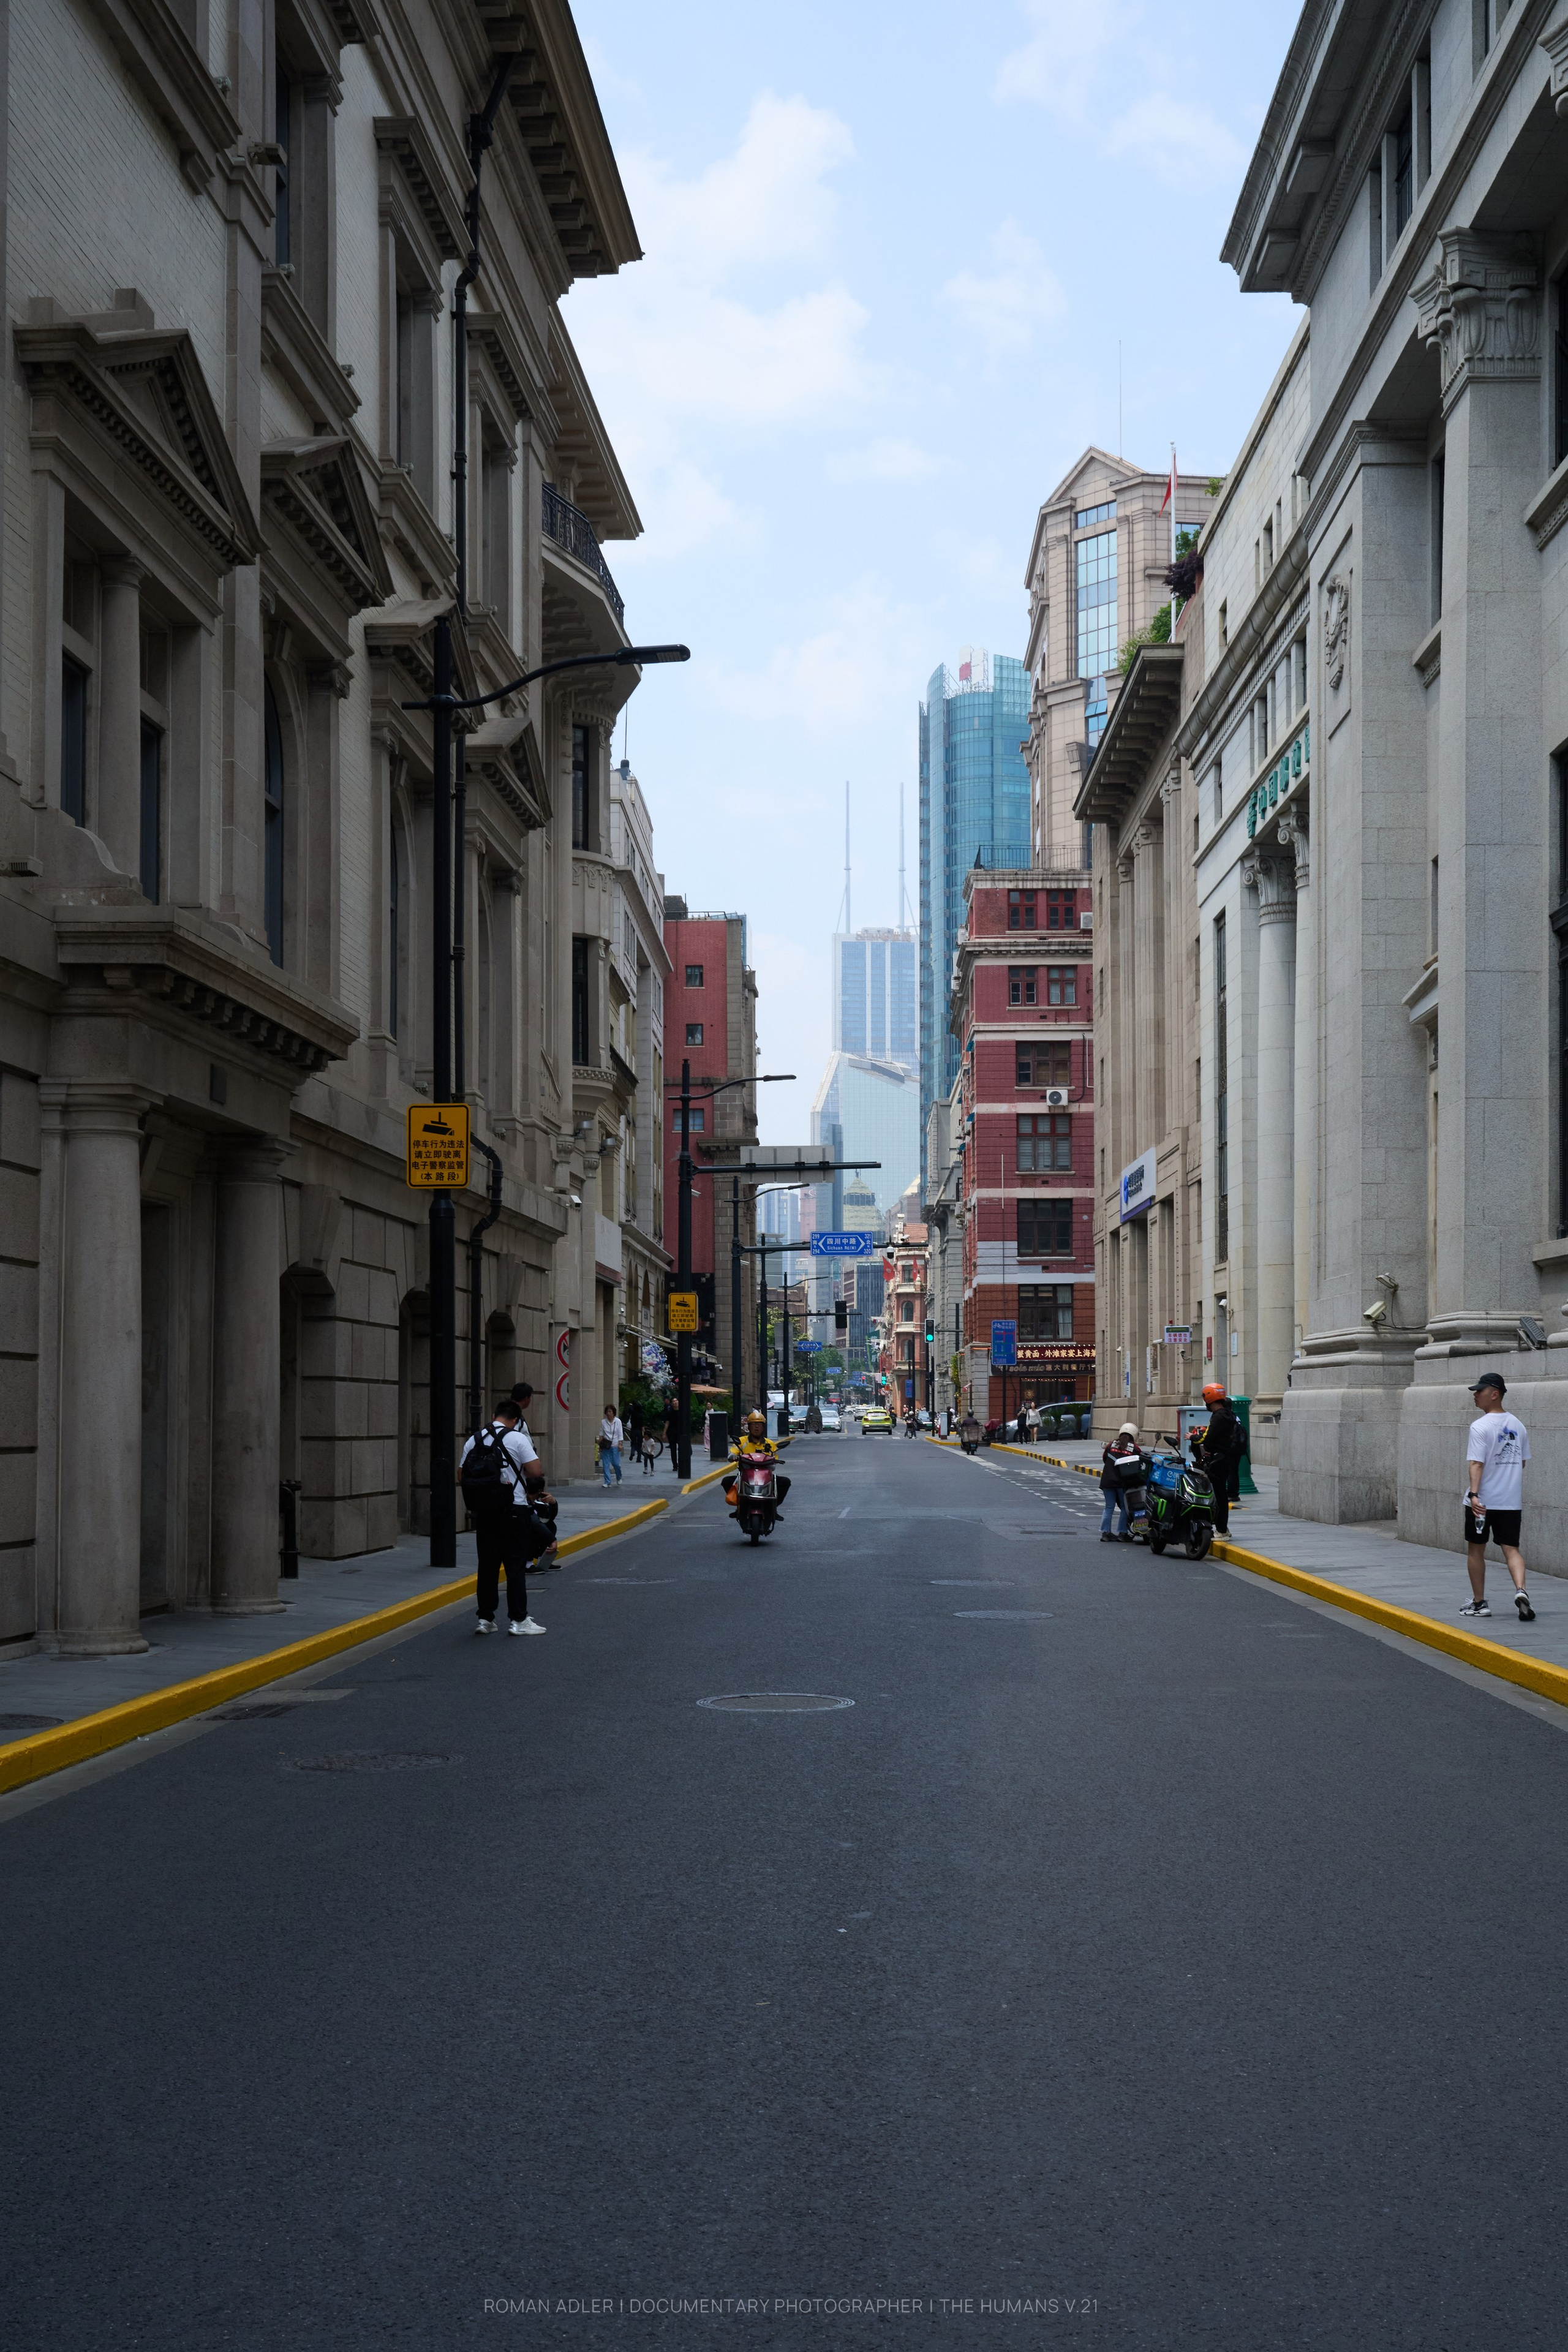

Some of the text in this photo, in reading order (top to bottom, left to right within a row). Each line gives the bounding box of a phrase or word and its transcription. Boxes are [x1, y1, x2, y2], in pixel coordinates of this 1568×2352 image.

[413, 1140, 464, 1148] 停车行为违法
[414, 1150, 461, 1159] 请立即驶离
[412, 1161, 464, 1170] 电子警察监管
